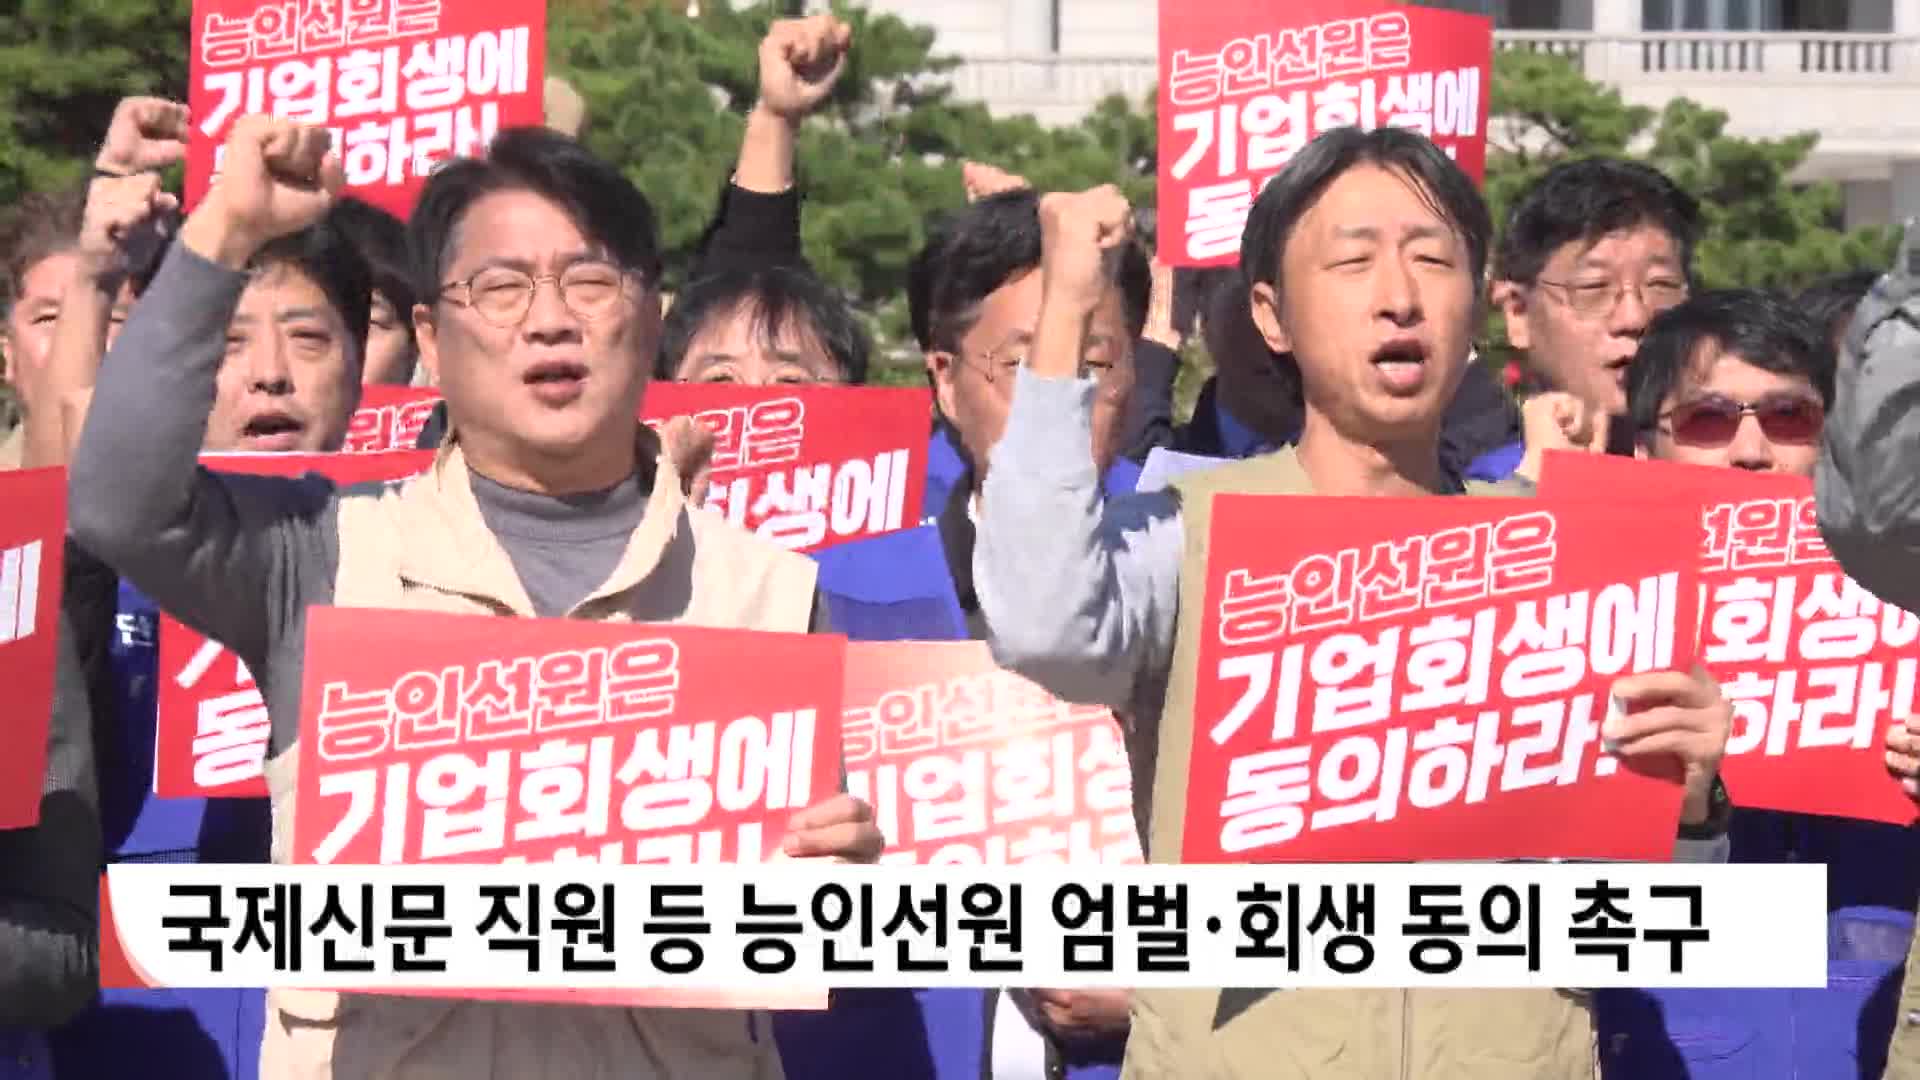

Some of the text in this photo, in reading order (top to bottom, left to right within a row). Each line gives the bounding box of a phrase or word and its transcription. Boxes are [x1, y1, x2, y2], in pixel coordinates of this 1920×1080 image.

[200, 27, 529, 138] 기업회생에
[1170, 12, 1411, 106] 능인선원은
[1170, 66, 1480, 181] 기업회생에
[1219, 511, 1557, 646] 능인선원은
[317, 638, 680, 761] 능인선원은
[1209, 572, 1680, 746] 기업회생에
[311, 708, 818, 864] 기업회생에
